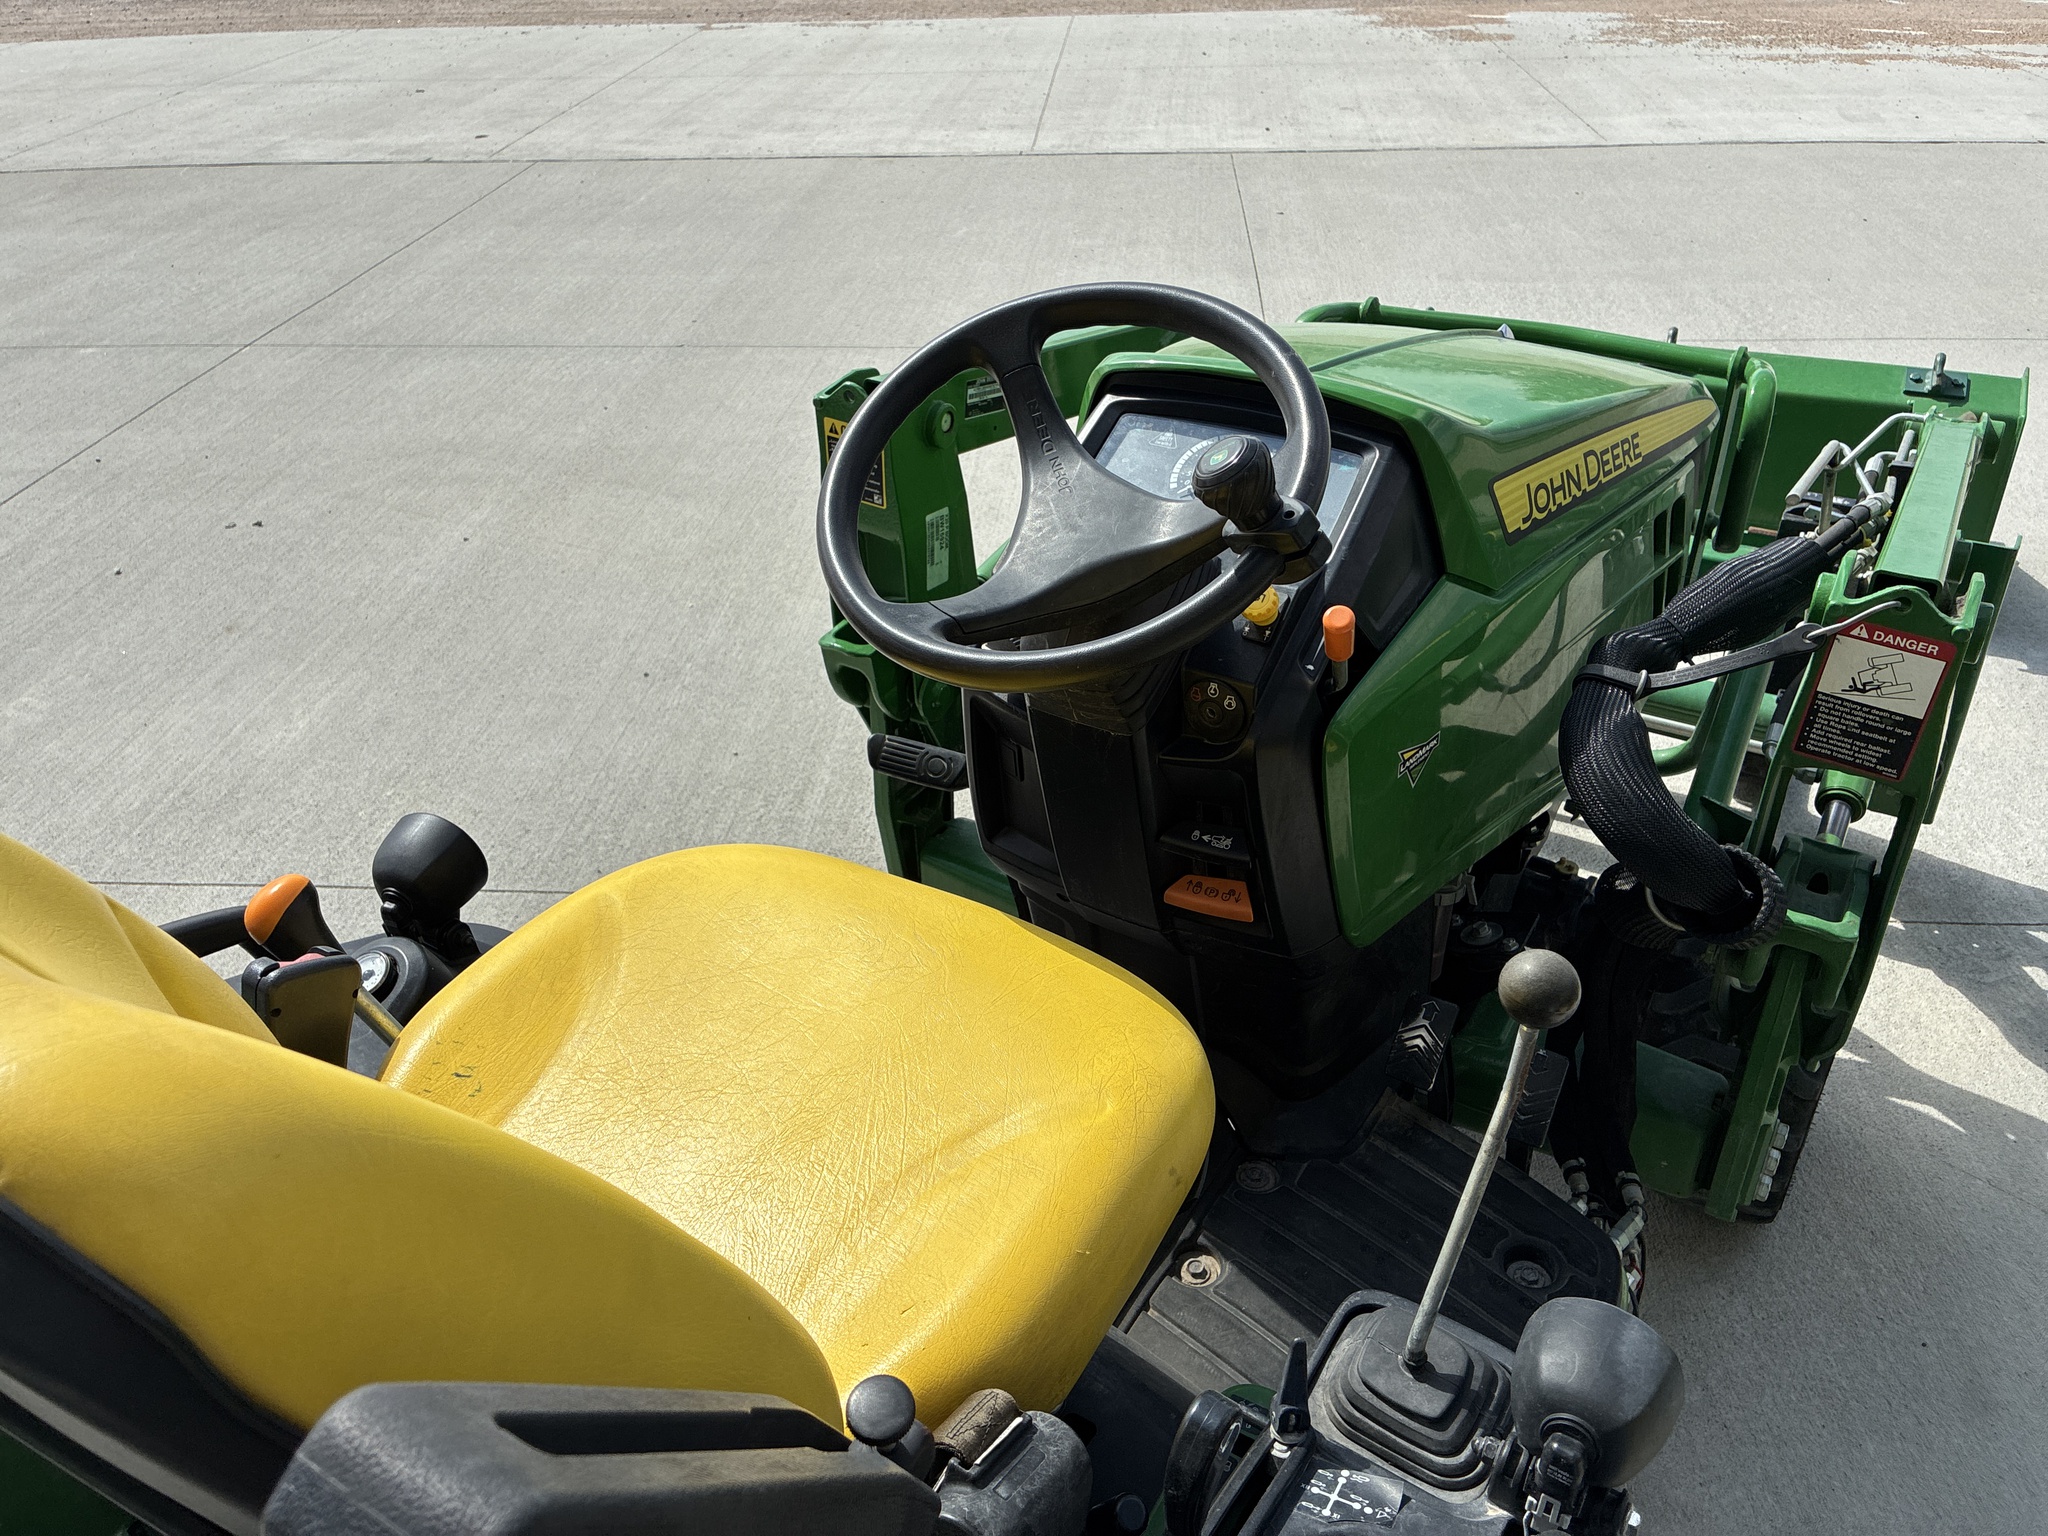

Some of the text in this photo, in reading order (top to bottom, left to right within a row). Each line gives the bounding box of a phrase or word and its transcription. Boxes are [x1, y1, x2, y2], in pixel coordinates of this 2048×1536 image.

[1027, 399, 1073, 494] JOHN DEERE
[1522, 431, 1642, 524] JOHN DEERE
[1873, 630, 1939, 656] DANGER
[1815, 699, 1834, 708] result
[1835, 704, 1850, 712] from
[1817, 693, 1842, 704] Serious
[1843, 700, 1861, 710] injury
[1871, 708, 1890, 717] death
[1818, 712, 1839, 722] square
[1842, 712, 1865, 722] handle
[1866, 719, 1885, 728] round
[1894, 727, 1912, 736] large
[1810, 733, 1827, 742] Move
[1828, 738, 1851, 749] wheels
[1861, 747, 1882, 758] widest
[1826, 732, 1853, 744] required
[1861, 730, 1888, 741] seatbelt
[1806, 744, 1831, 755] Operate
[1833, 751, 1854, 761] tractor
[1808, 738, 1853, 755] recommended
